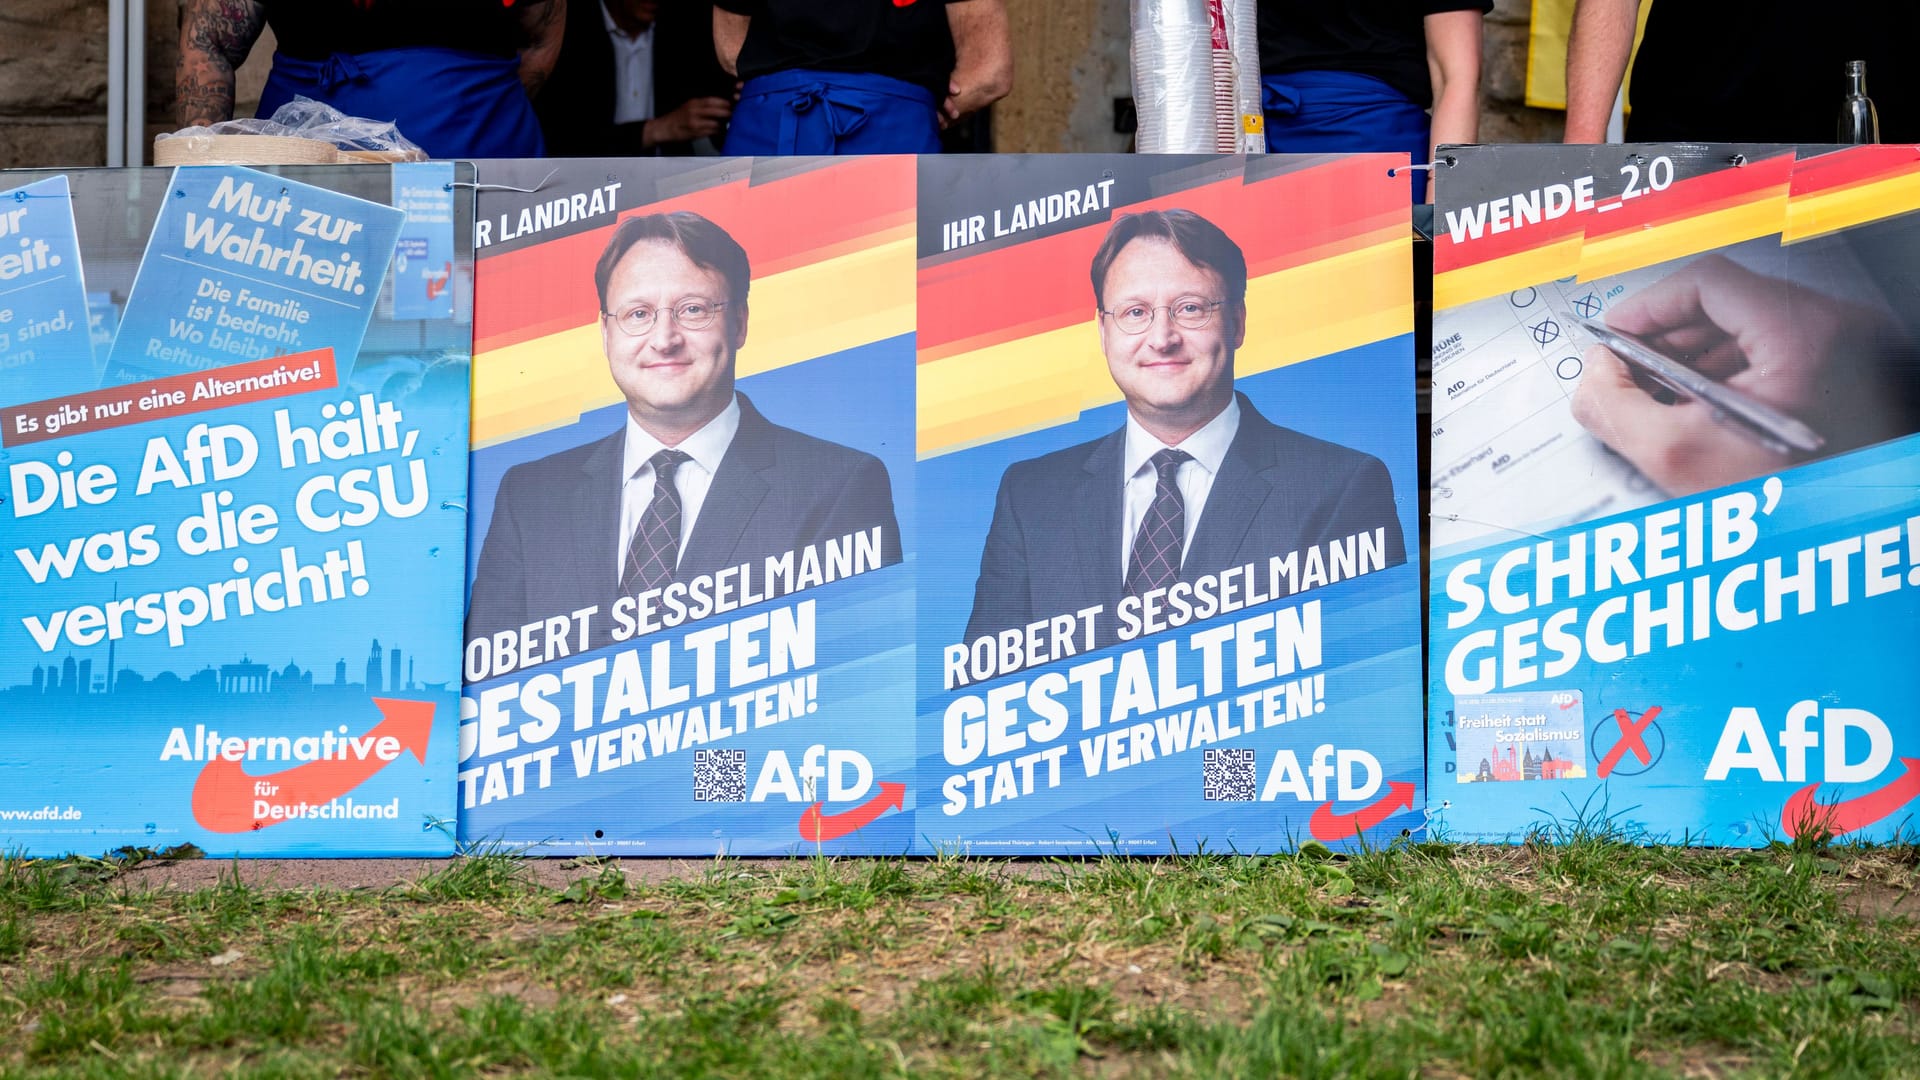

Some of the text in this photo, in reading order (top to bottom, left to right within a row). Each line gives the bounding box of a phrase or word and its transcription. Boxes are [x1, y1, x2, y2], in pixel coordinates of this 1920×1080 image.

[208, 175, 364, 245] Mut zur
[500, 182, 622, 242] LANDRAT
[943, 179, 1115, 251] IHR LANDRAT
[1445, 156, 1674, 244] WENDE_2.0
[184, 212, 365, 297] Wahrheit.
[18, 310, 73, 341] sind,
[187, 299, 302, 346] ist bedroht.
[197, 278, 310, 325] Die Familie
[169, 318, 268, 360] Wo bleibt
[16, 361, 322, 437] Es gibt nur eine Alternative!
[1447, 380, 1465, 396] AfD
[9, 393, 420, 518] Die AfD hält,
[14, 458, 430, 584] was die CSU
[22, 540, 370, 653] verspricht!
[611, 525, 882, 641] SESSELMANN
[943, 527, 1386, 690] ROBERT SESSELMANN
[1444, 516, 1920, 696] GESCHICHTE!
[943, 599, 1323, 766] GESTALTEN
[1551, 694, 1573, 704] AfD
[160, 724, 400, 762] Alternative
[571, 673, 818, 778] VERWALTEN!
[942, 673, 1326, 816] STATT VERWALTEN!
[1459, 713, 1547, 728] Freiheit statt
[1495, 728, 1580, 742] Sozialismus
[1704, 700, 1894, 784] AfD
[254, 781, 279, 796] für
[750, 745, 874, 803] AfD
[1260, 743, 1383, 802] AfD
[0, 806, 82, 820] ww.afd.de
[254, 798, 399, 820] Deutschland
